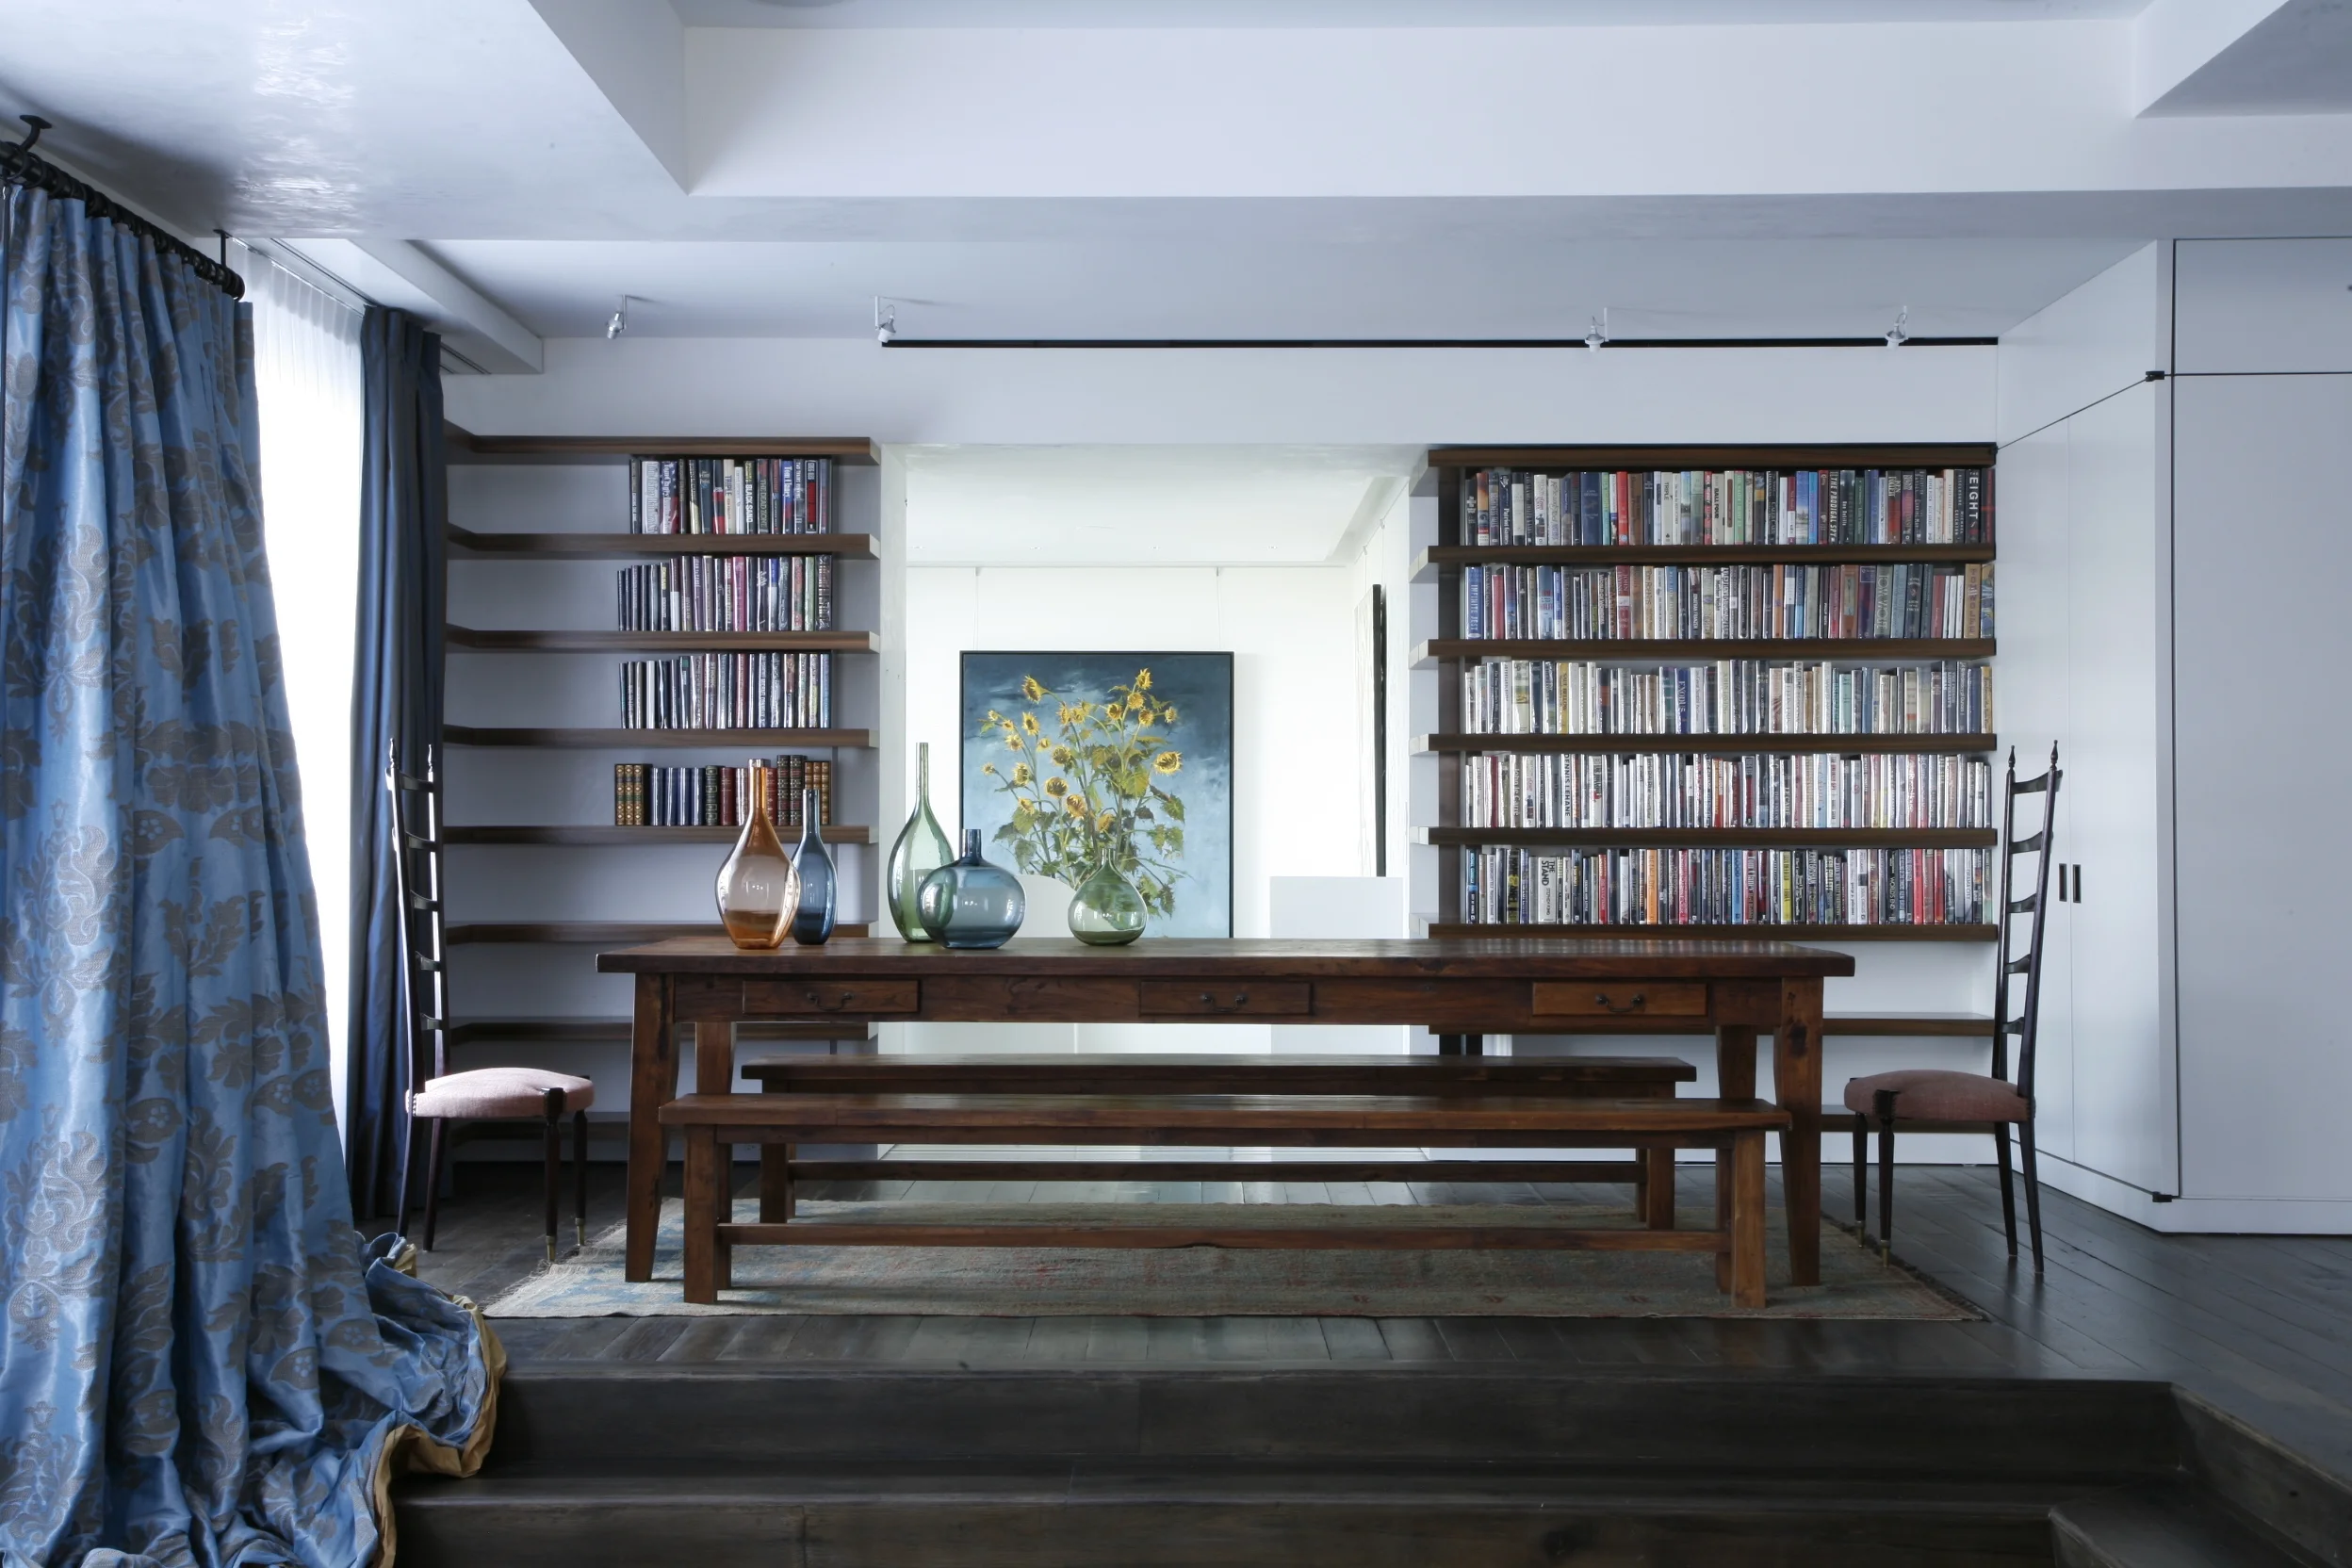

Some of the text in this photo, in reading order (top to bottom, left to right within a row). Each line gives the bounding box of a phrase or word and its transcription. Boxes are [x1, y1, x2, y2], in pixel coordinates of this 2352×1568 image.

[783, 466, 792, 498] Tom Clancy
[1968, 477, 1979, 519] EIGHT
[1470, 584, 1478, 630] INFINITE JEST
[1876, 575, 1889, 629] TOM WOLFE
[1747, 870, 1756, 891] Clancy
